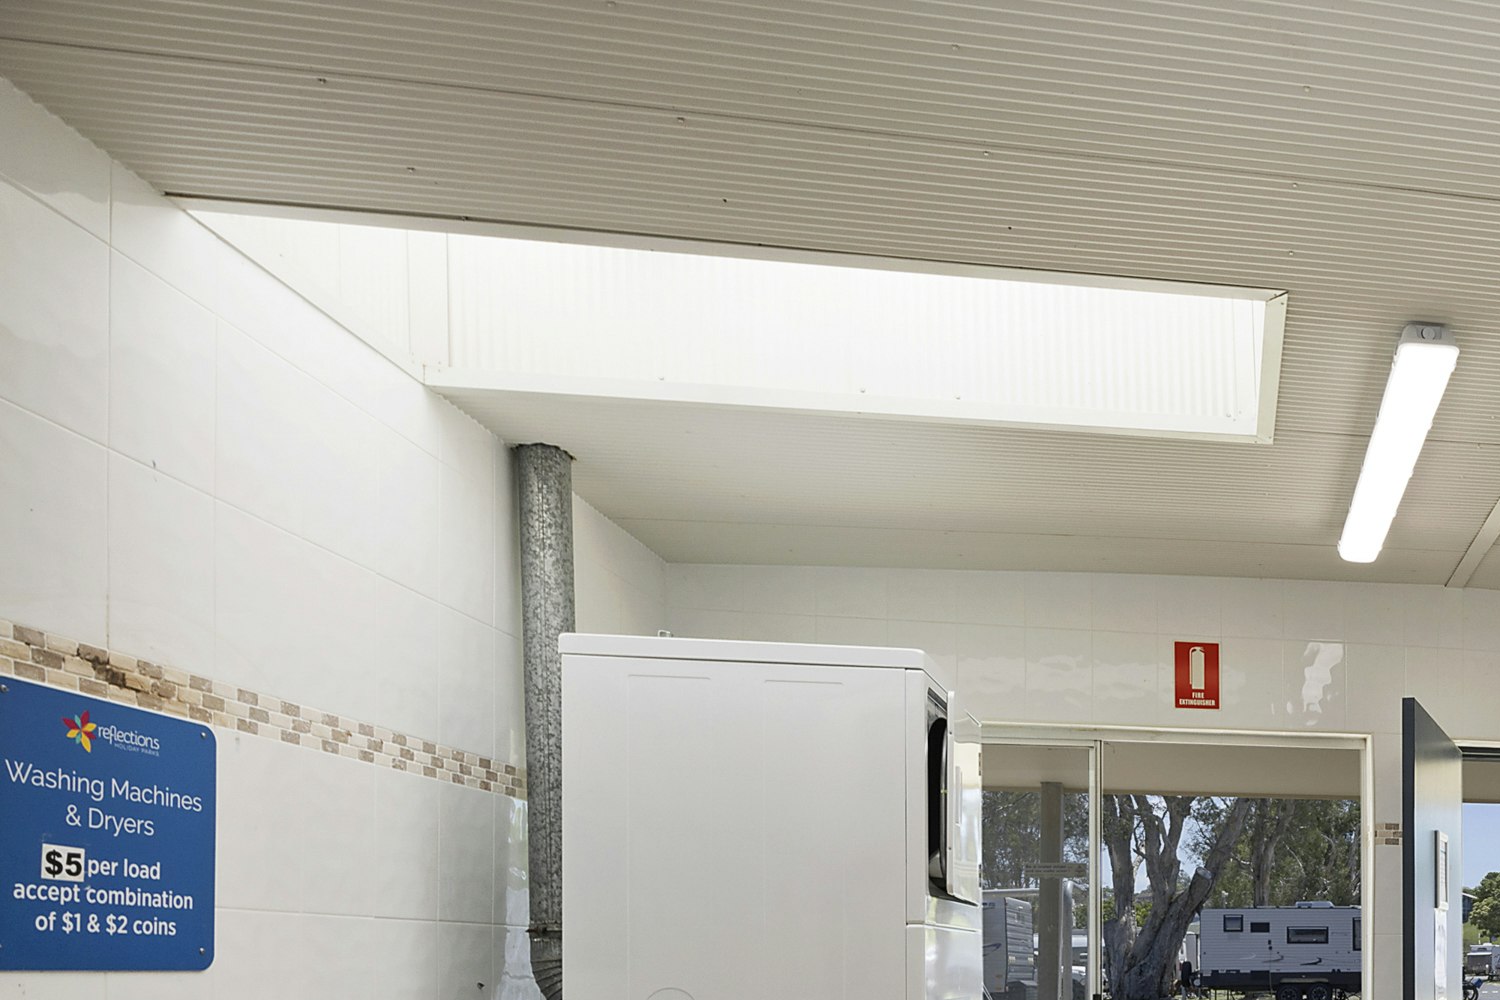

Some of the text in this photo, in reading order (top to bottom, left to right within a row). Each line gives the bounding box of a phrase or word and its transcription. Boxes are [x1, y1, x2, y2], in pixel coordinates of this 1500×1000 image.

[1179, 698, 1215, 706] EXTINGUISHER
[98, 725, 160, 750] reflections
[5, 758, 202, 812] Washing Machines
[65, 804, 155, 838] & Dryers
[44, 850, 161, 880] $5 per load
[12, 881, 194, 910] accept combination
[35, 912, 177, 936] of $1 & $2 coins
